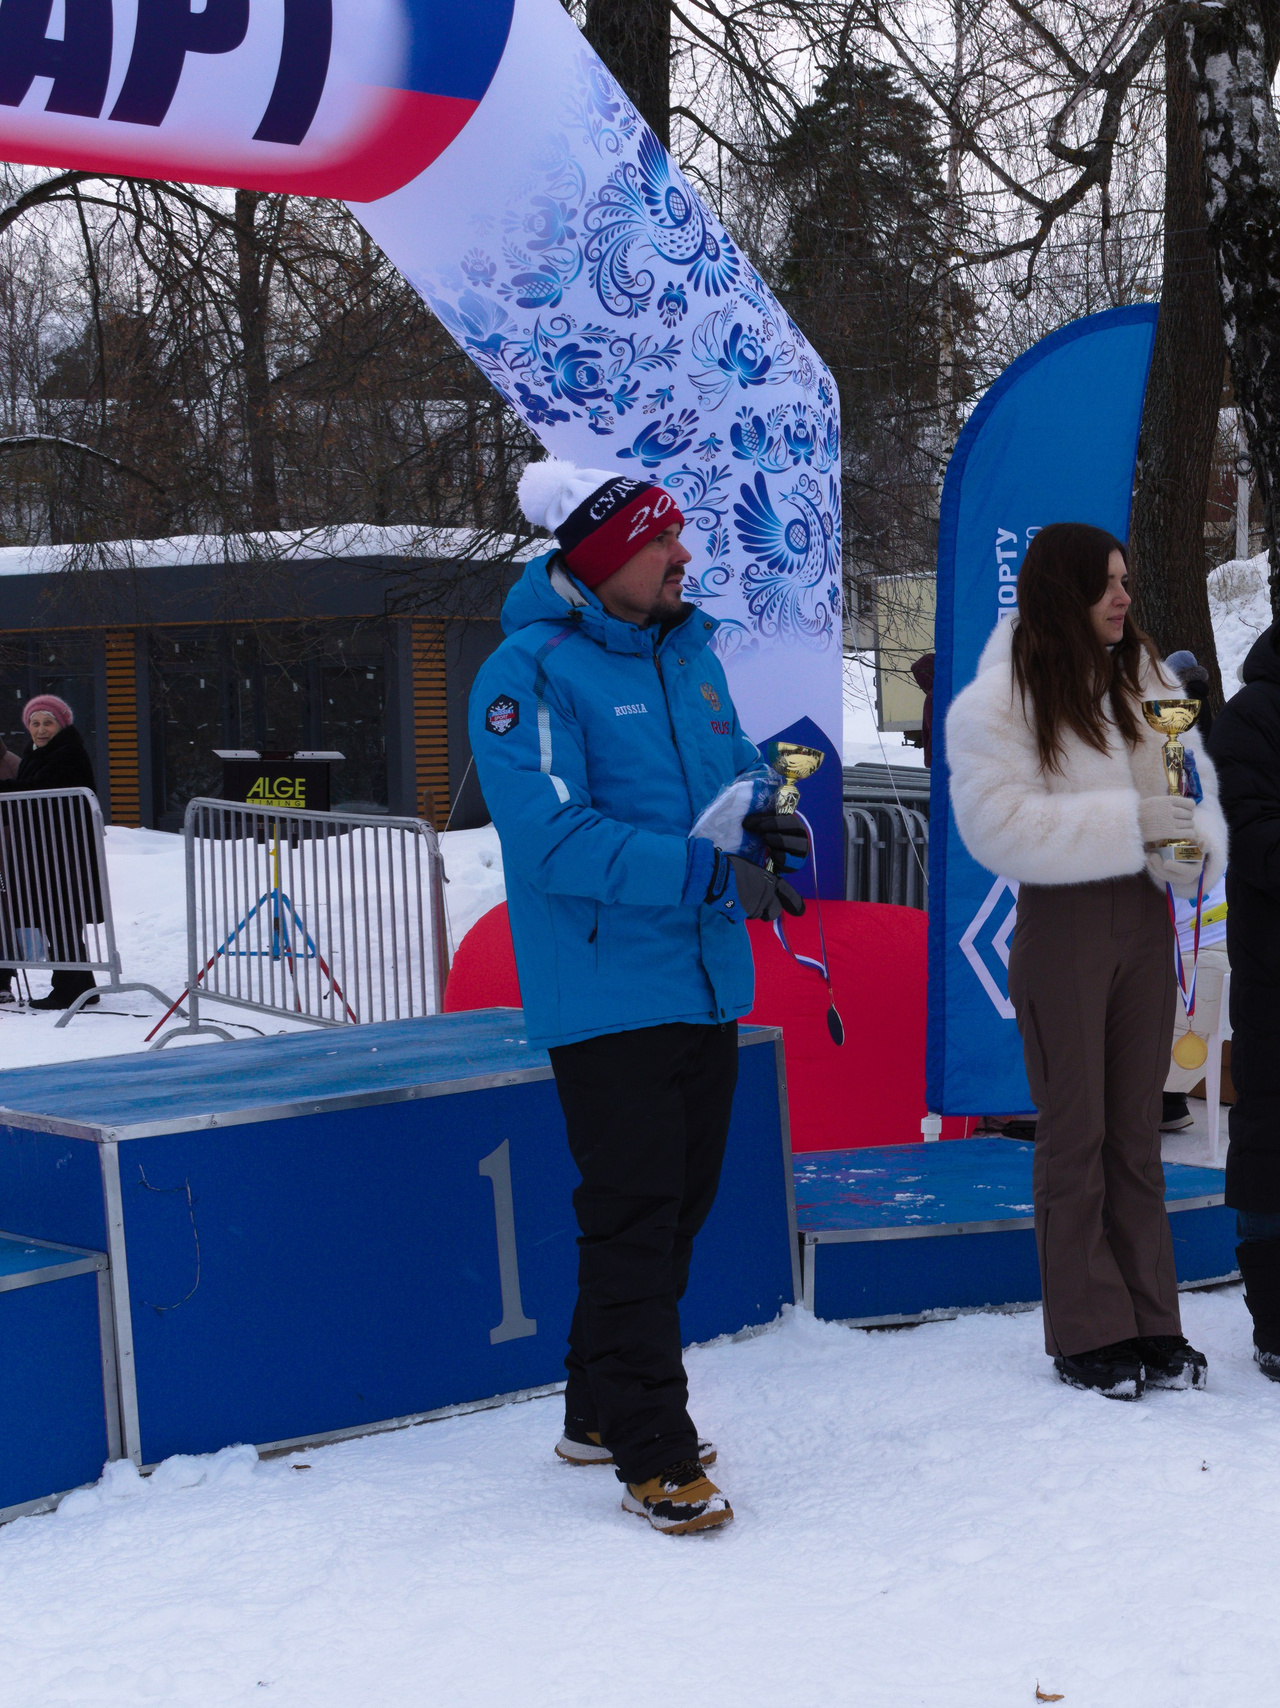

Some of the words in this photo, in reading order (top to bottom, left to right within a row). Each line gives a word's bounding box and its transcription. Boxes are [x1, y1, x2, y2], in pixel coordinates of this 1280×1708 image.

[626, 494, 681, 542] 20
[614, 703, 648, 716] RUSSIA
[710, 720, 730, 735] RUS
[246, 776, 306, 799] ALGE
[479, 1138, 538, 1345] 1
